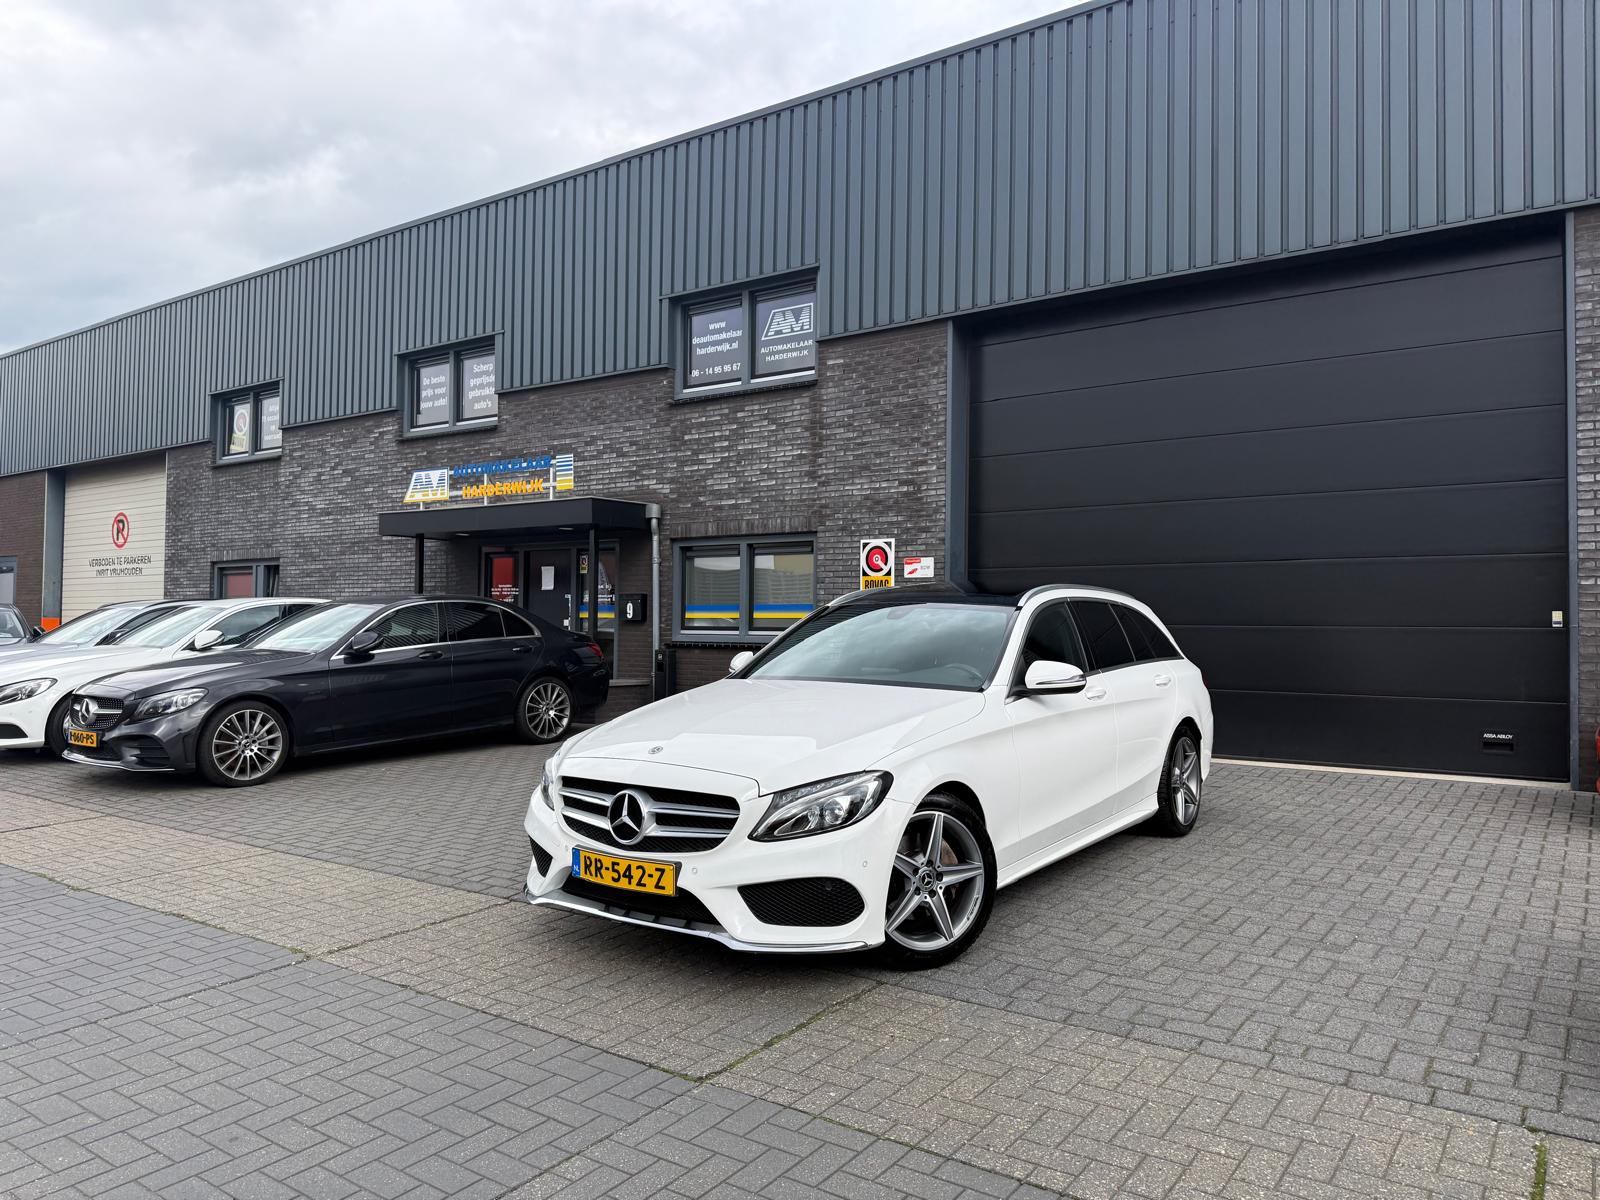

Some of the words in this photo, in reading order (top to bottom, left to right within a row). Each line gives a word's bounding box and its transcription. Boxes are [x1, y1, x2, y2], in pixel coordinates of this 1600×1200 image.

[708, 321, 726, 330] www
[692, 329, 743, 345] deautomakelaar
[696, 341, 739, 355] harderwijk.nl
[760, 340, 813, 354] AUTOMAKELAAR
[765, 350, 809, 362] HARDERWIJK
[472, 363, 494, 373] Scherp
[691, 369, 700, 377] 06
[705, 367, 713, 375] 14
[714, 365, 722, 374] 95
[723, 364, 732, 372] 95
[732, 362, 741, 371] 67
[422, 377, 430, 386] De
[430, 375, 446, 384] beste
[473, 399, 492, 410] auto's
[453, 455, 551, 478] AUTOMAKELAAR
[462, 478, 544, 499] HARDERWIJK
[89, 557, 115, 568] VERBODEN
[116, 556, 123, 566] TE
[123, 555, 152, 566] PARKEREN
[95, 568, 109, 577] INRIT
[626, 602, 633, 619] 9
[583, 855, 666, 890] RR-542-Z
